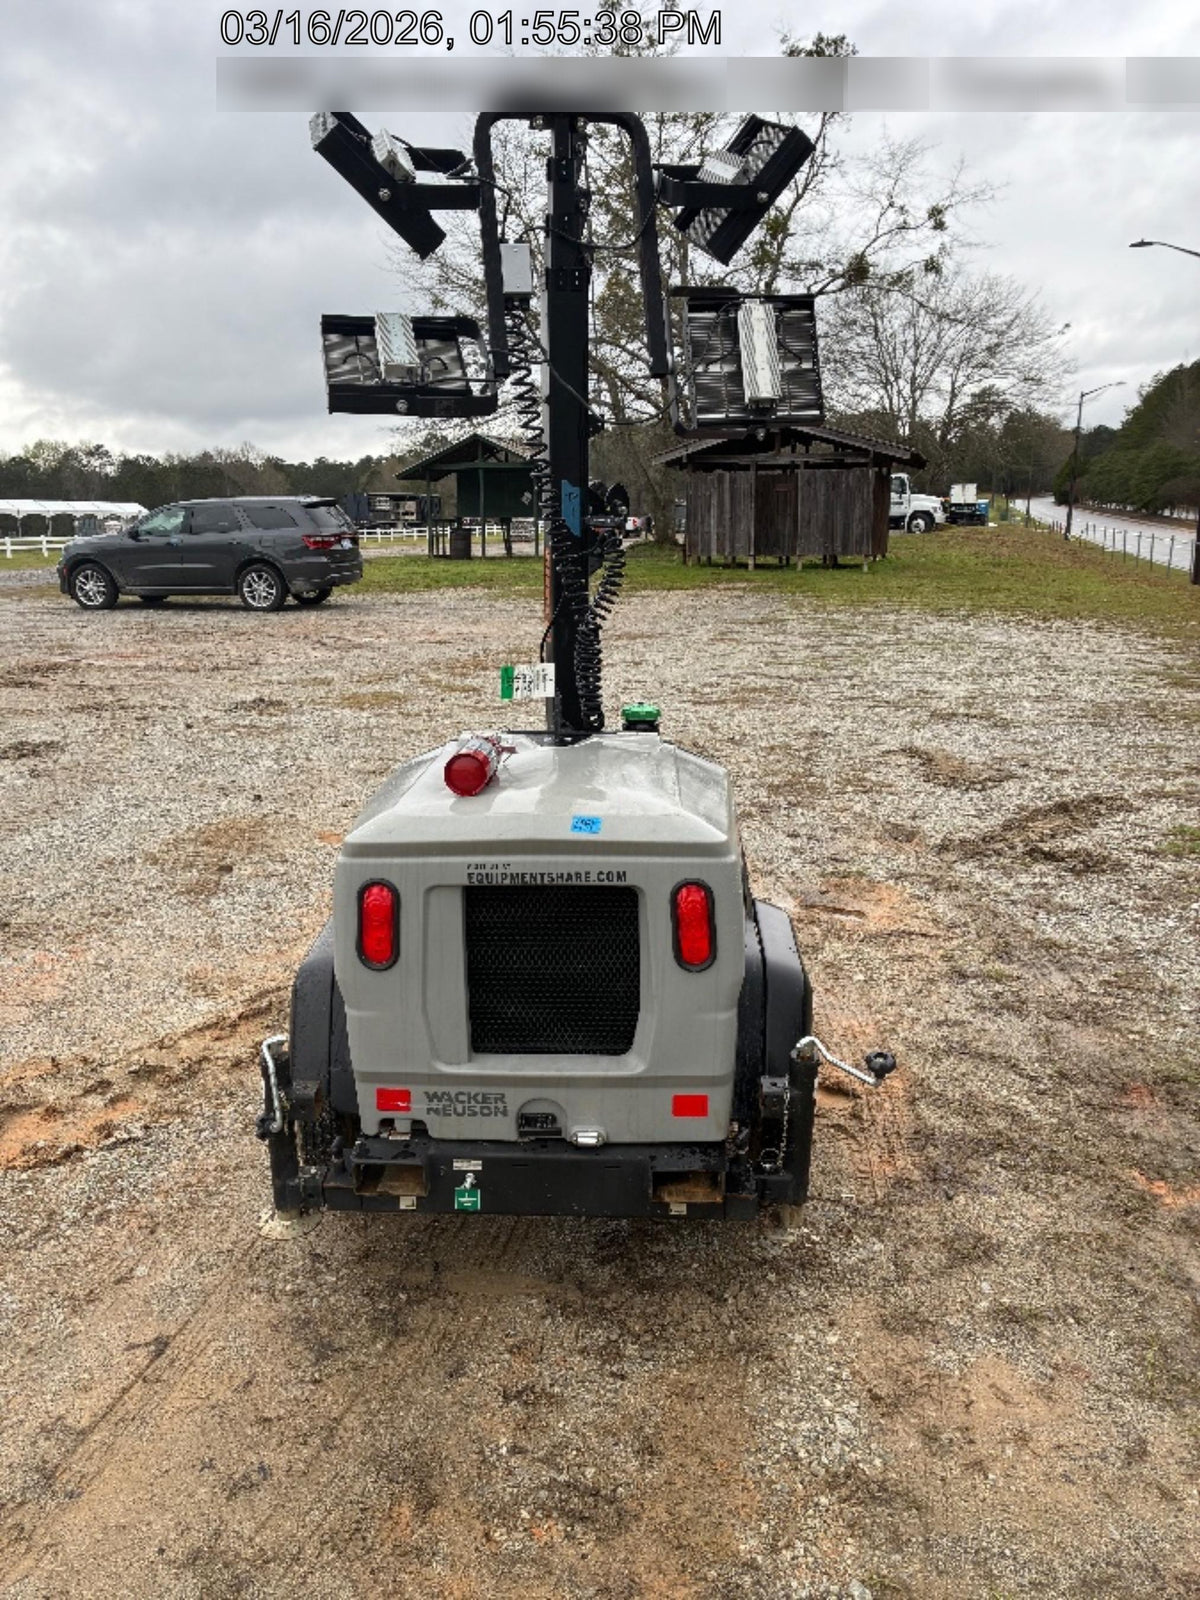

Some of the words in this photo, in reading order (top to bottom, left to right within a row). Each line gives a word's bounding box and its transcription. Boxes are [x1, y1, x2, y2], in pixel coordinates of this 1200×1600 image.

[466, 870, 628, 885] EQUIPMENTSHARE.COM
[423, 1090, 508, 1105] WACKER
[425, 1103, 509, 1117] NEUSON
